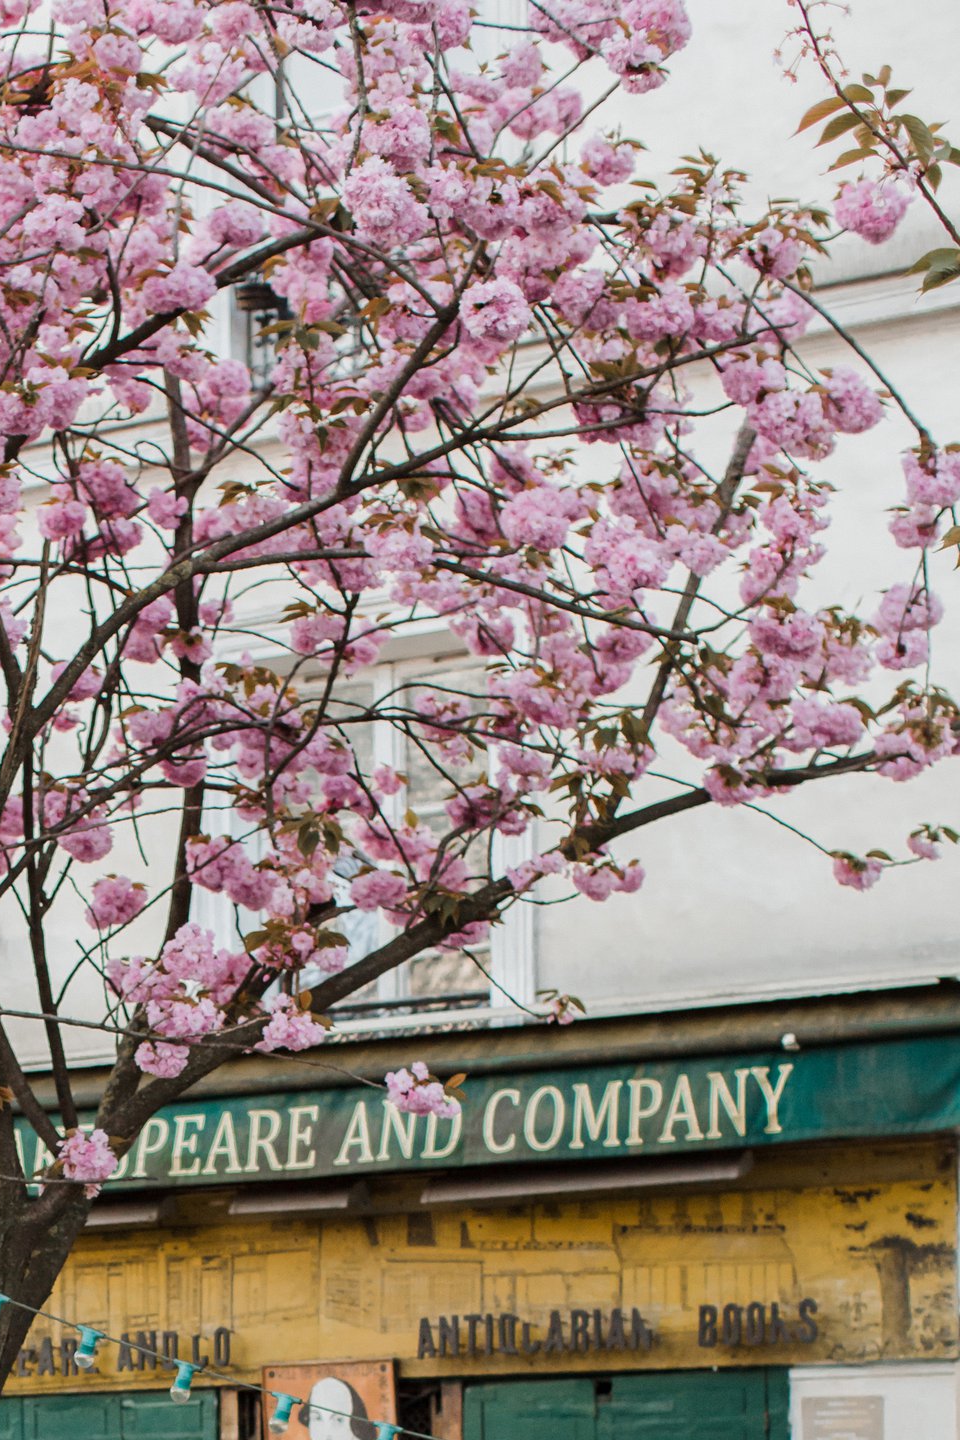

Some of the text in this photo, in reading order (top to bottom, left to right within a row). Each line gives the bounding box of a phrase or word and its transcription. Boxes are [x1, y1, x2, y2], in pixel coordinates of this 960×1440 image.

[333, 1100, 463, 1166] AND
[483, 1063, 794, 1155] COMPANY
[698, 1297, 818, 1348] BOOKS
[117, 1329, 179, 1372] AND
